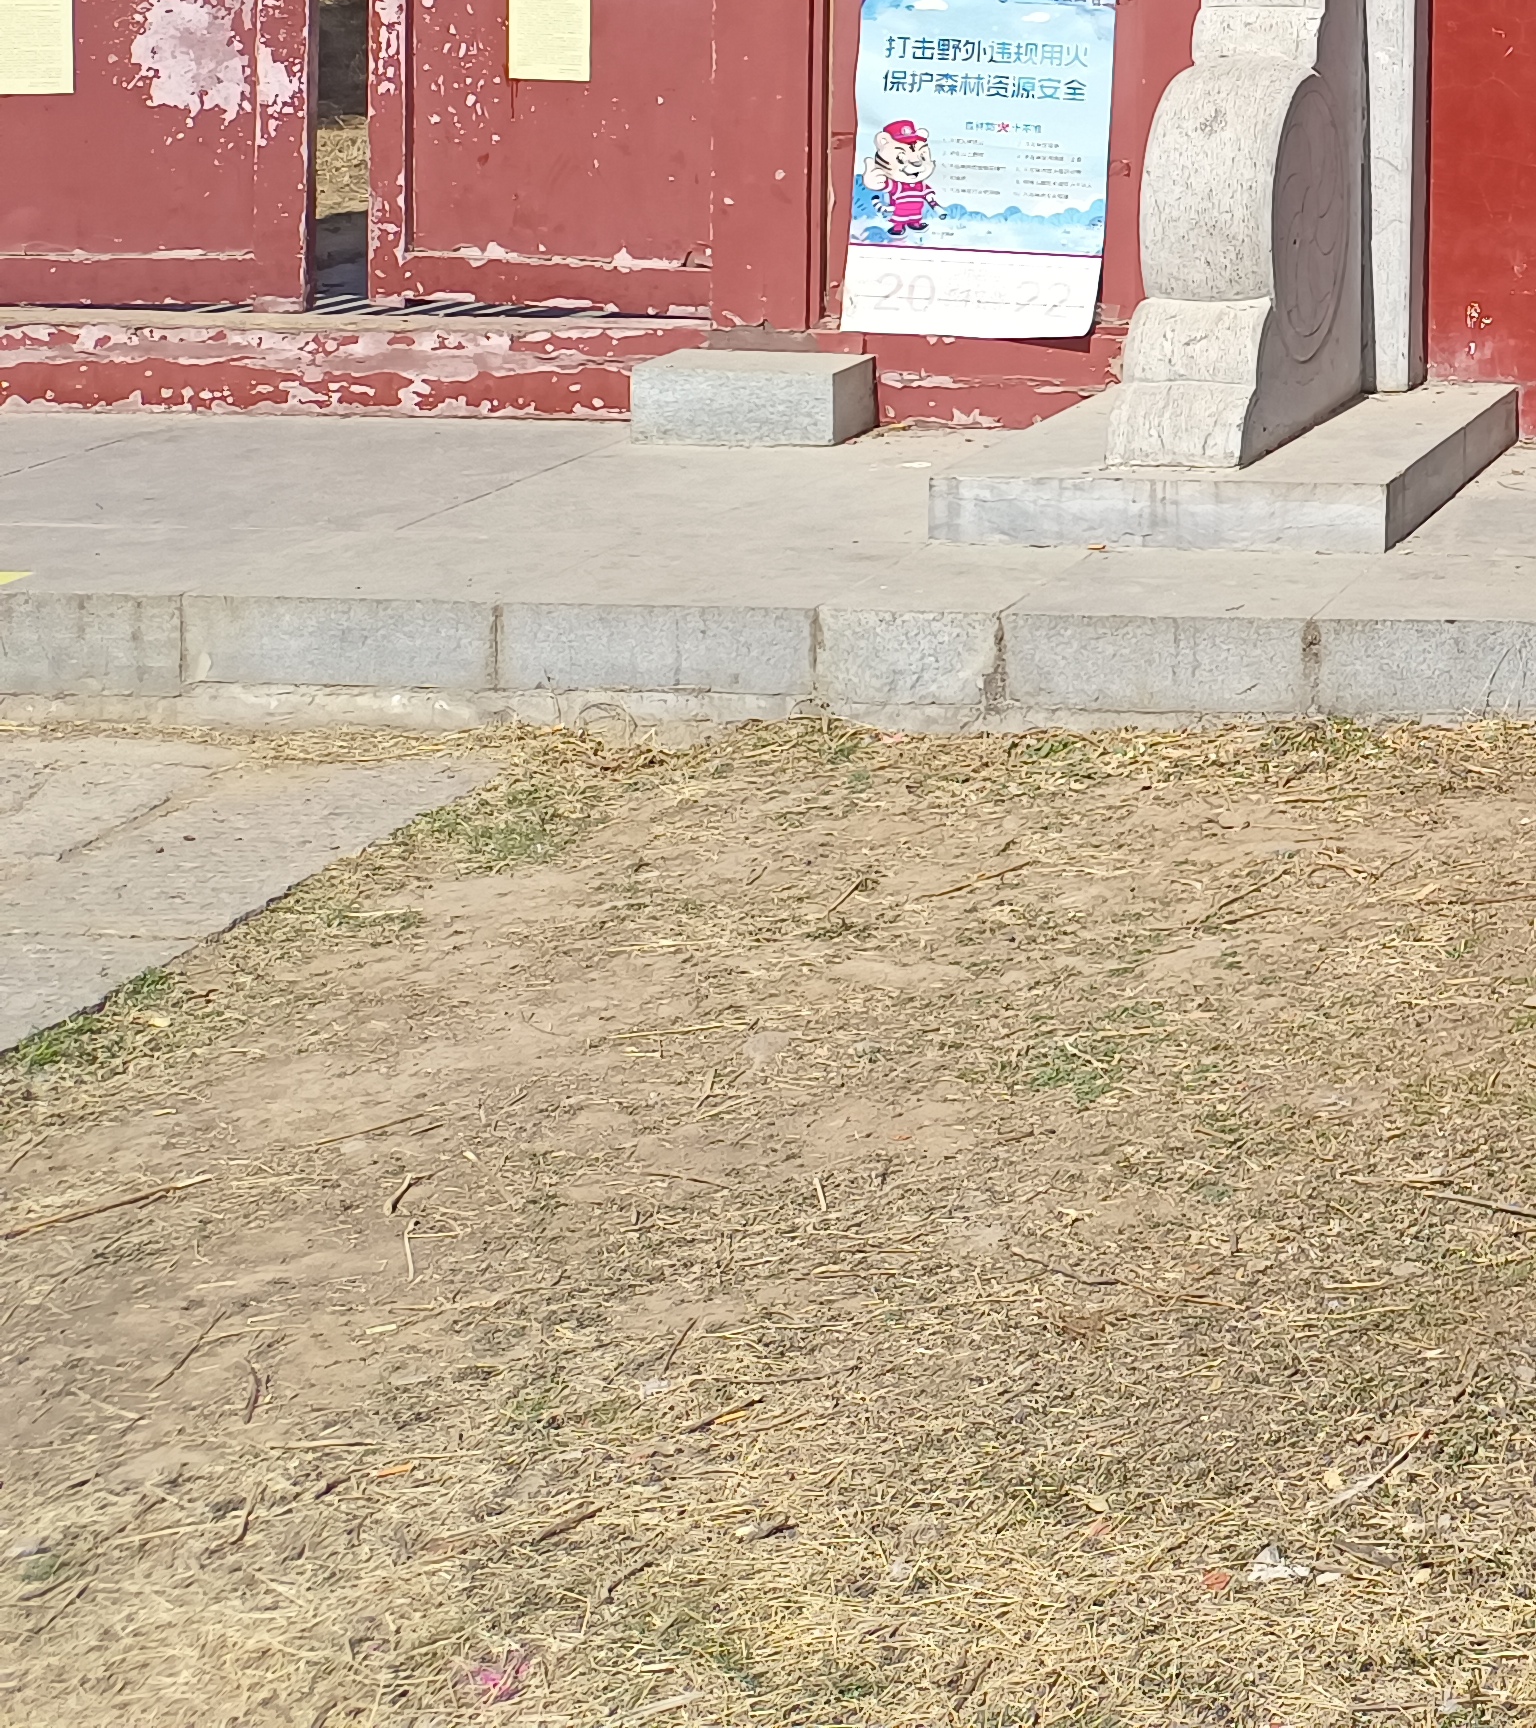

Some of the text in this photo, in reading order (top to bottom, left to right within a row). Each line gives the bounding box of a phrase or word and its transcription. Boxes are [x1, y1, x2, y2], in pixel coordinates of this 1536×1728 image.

[885, 34, 1089, 68] 打击野外违规用火
[882, 69, 1088, 103] 保护森林资源安全
